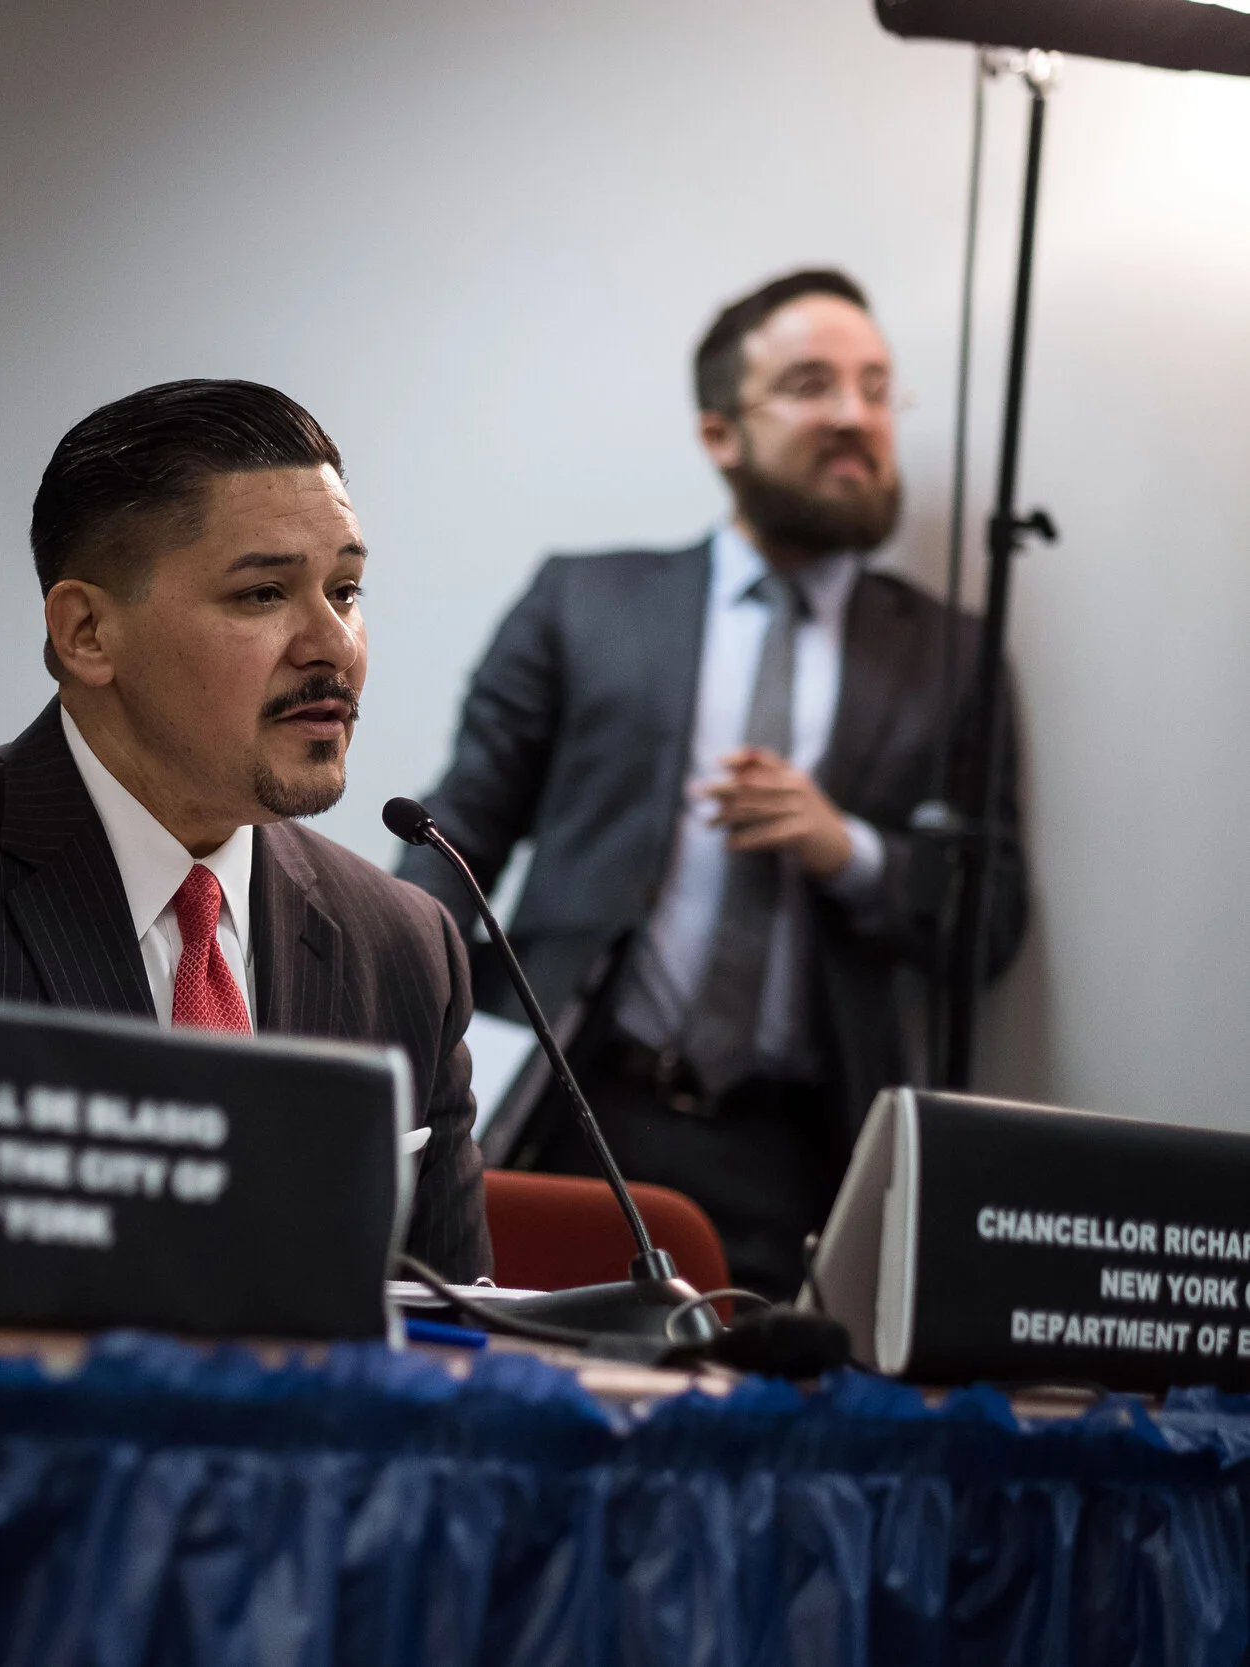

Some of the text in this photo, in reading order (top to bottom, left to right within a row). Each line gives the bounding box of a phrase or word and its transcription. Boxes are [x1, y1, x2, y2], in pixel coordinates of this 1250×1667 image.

[976, 1206, 1158, 1252] CHANCELLOR
[1100, 1267, 1159, 1301] NEW
[1166, 1273, 1238, 1307] YORK
[1011, 1309, 1190, 1352] DEPARTMENT
[1197, 1325, 1230, 1355] OF
